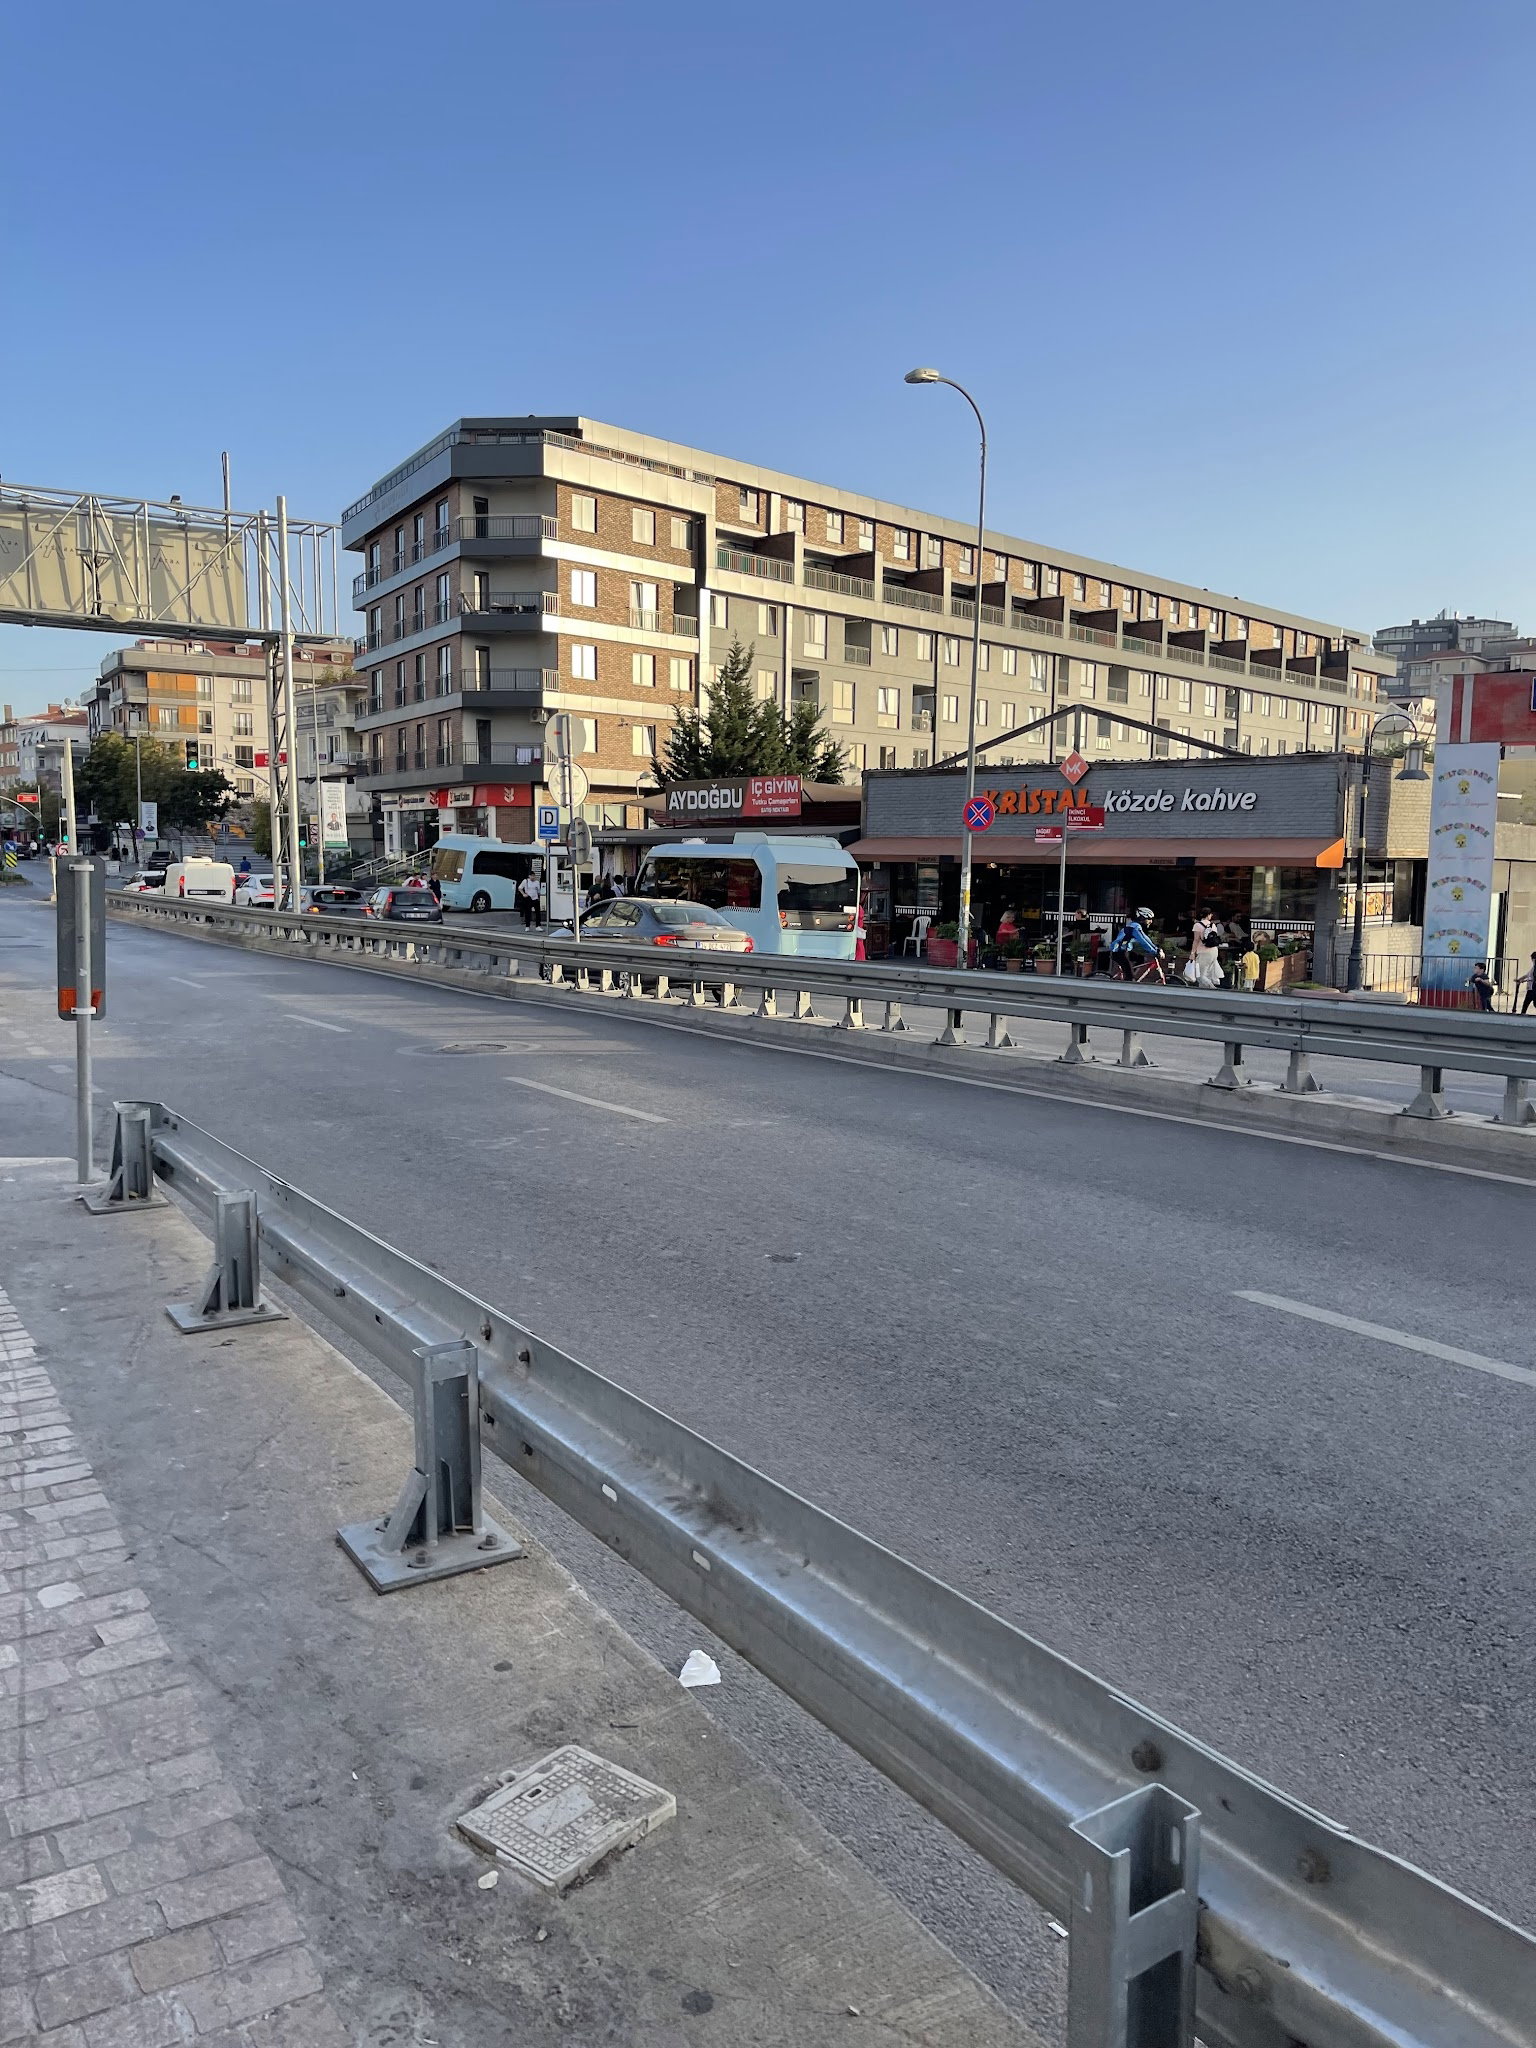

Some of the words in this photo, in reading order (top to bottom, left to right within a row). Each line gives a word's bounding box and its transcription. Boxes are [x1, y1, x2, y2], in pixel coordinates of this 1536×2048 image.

[1065, 761, 1082, 775] MK
[668, 783, 743, 811] AYDOĞDU
[751, 778, 763, 797] İÇ
[764, 777, 799, 794] GİYİM
[982, 784, 1093, 814] KRİSTAL
[1103, 789, 1175, 813] közde
[1180, 787, 1257, 811] kahve
[544, 811, 554, 825] D
